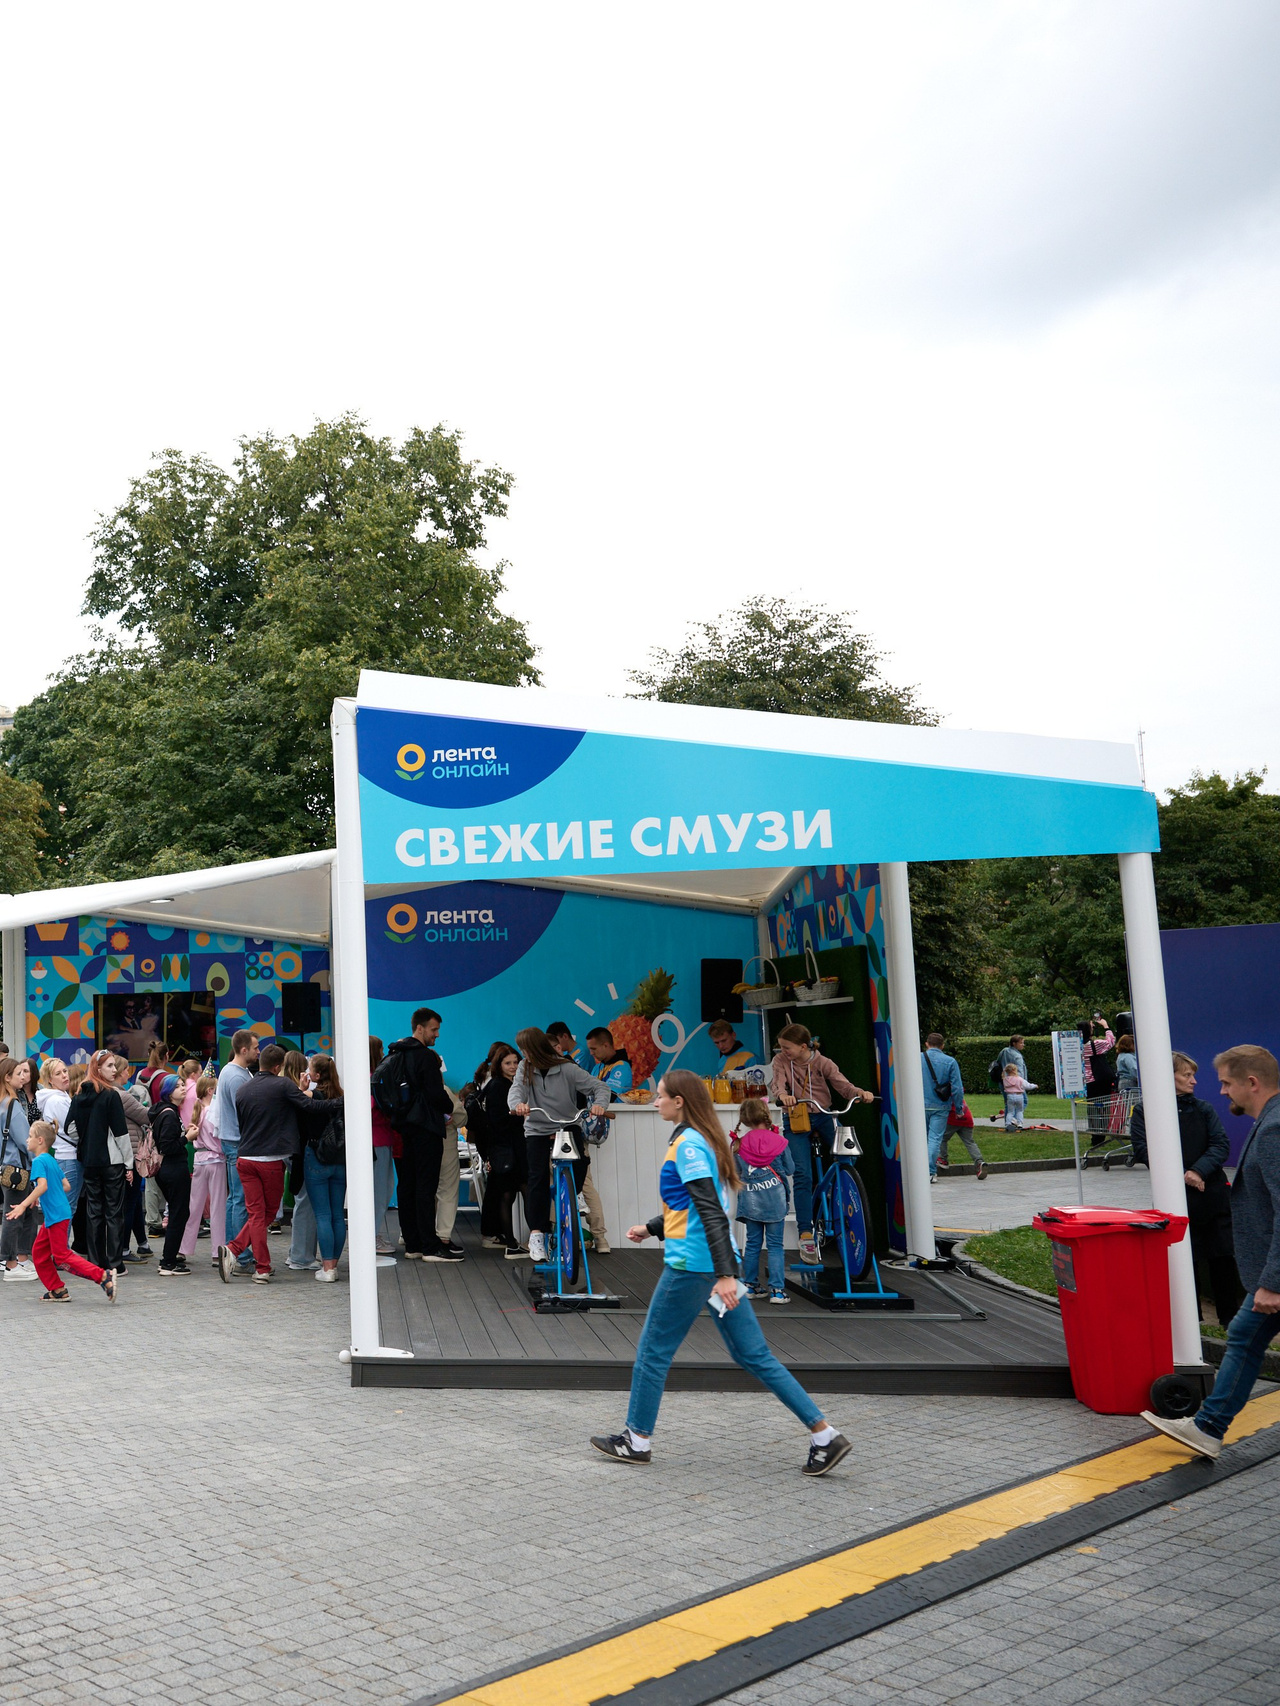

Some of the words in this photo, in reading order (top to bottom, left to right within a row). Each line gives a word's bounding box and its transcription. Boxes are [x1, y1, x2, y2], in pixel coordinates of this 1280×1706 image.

[431, 744, 497, 764] лента
[431, 760, 510, 780] онлайн
[395, 819, 614, 867] СВЕЖИЕ
[630, 808, 833, 857] СМУЗИ
[424, 907, 495, 926] лента
[424, 924, 509, 944] онлайн
